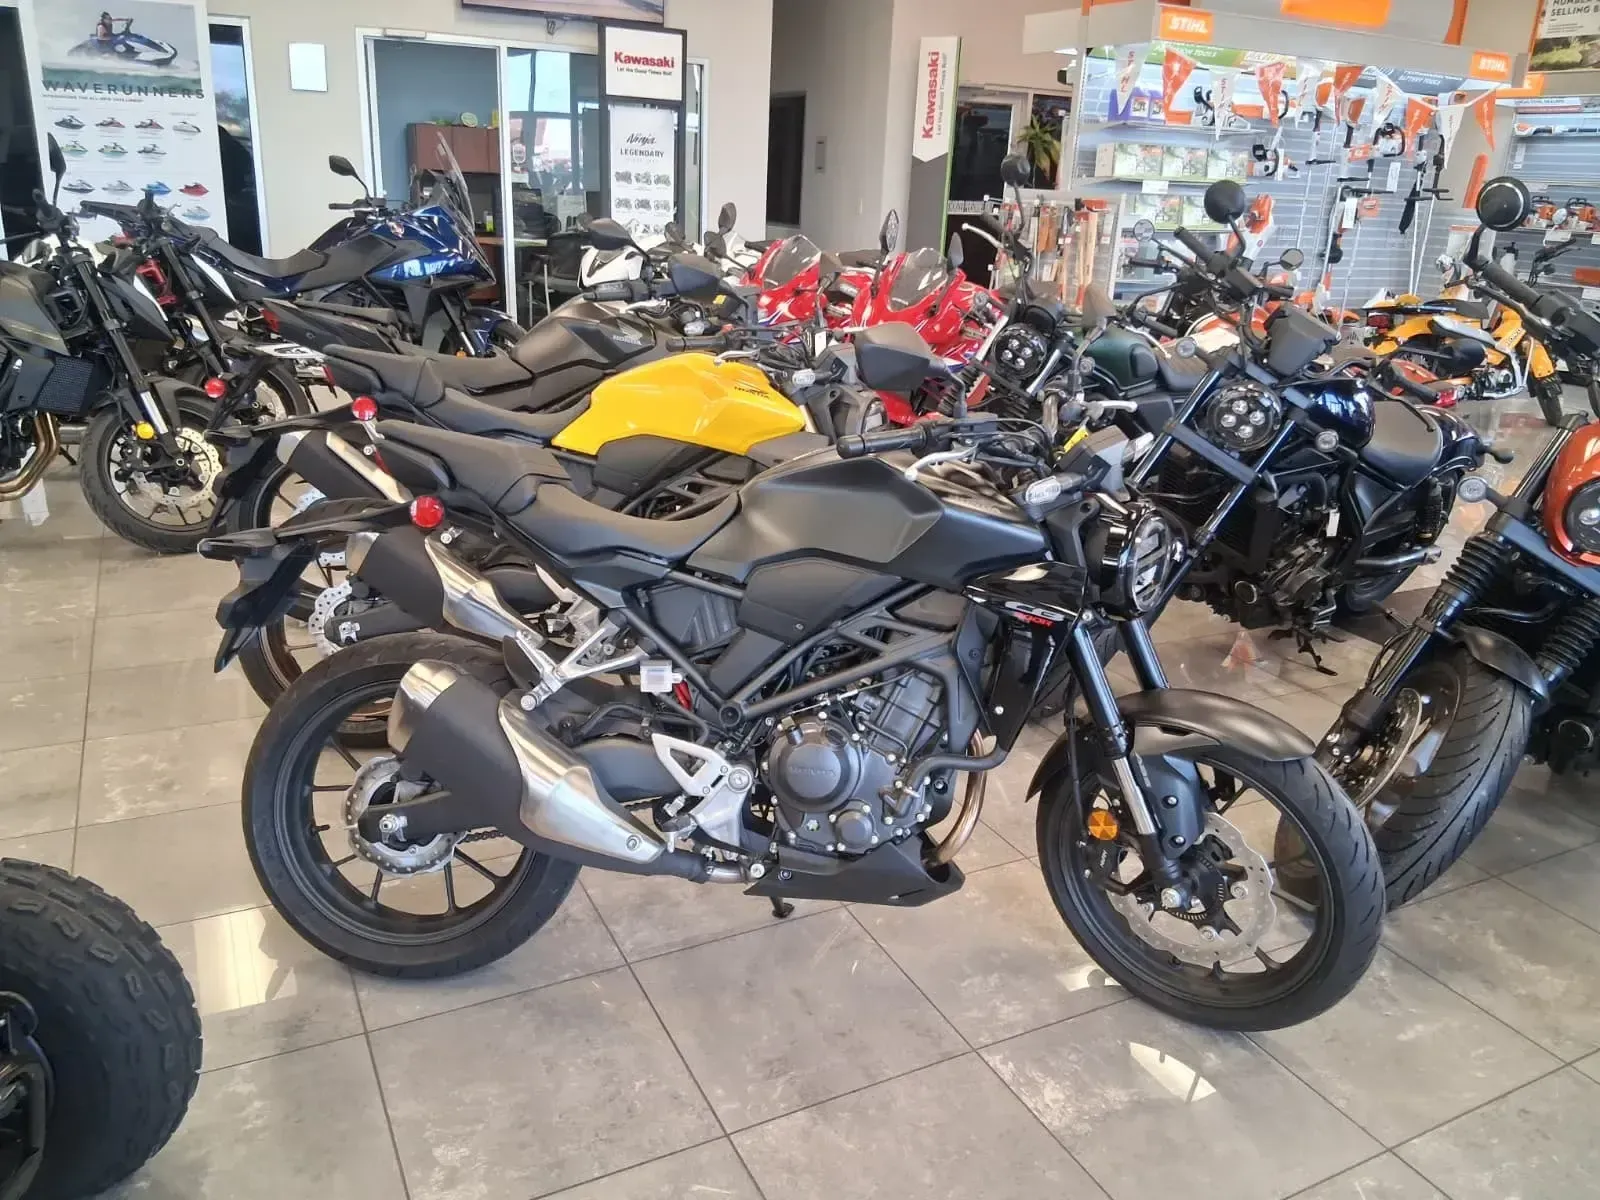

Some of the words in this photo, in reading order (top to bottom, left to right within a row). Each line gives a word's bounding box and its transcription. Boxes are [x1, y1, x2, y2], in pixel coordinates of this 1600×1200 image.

[1551, 6, 1590, 16] SELLING
[1170, 16, 1208, 33] STIHL
[614, 51, 675, 68] Kawasaki
[1479, 57, 1507, 73] STIHL
[42, 79, 205, 99] WAVERUNNERS
[922, 51, 940, 139] Kawasaki
[626, 132, 656, 146] Ninja
[620, 147, 664, 158] LEGENDARY
